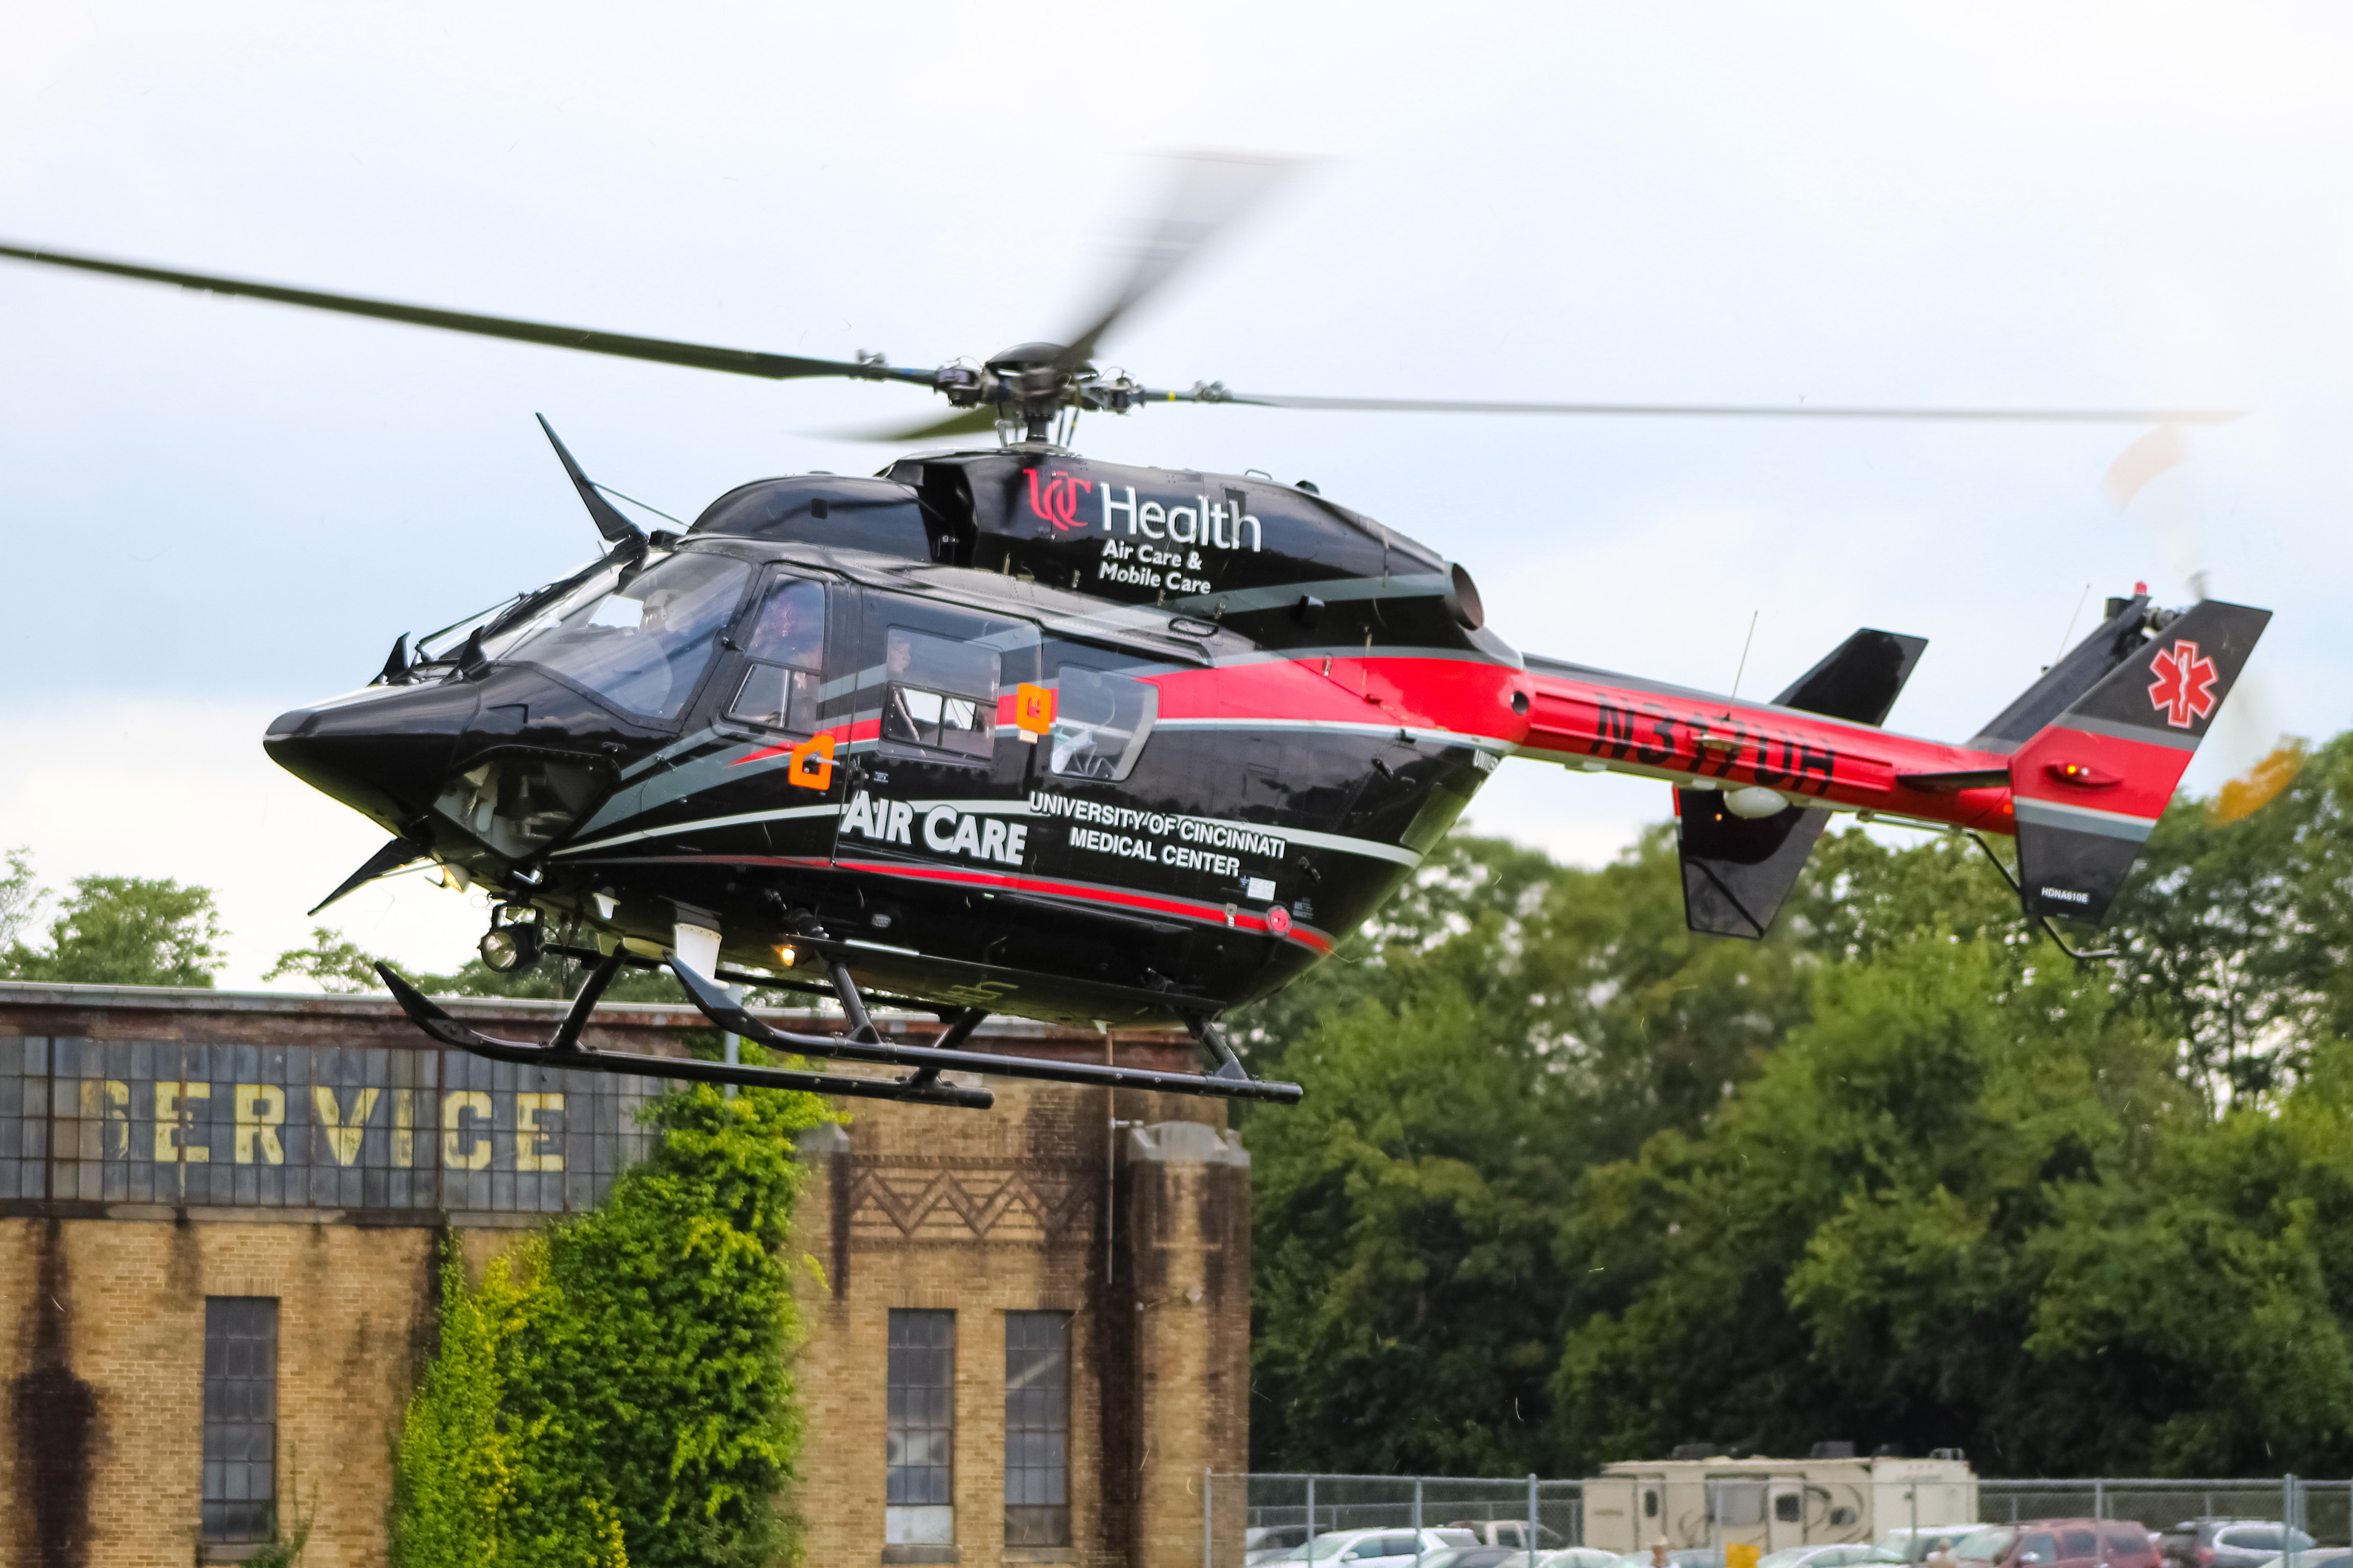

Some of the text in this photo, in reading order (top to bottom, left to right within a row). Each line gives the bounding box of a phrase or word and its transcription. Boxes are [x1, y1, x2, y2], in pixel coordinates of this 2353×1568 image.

[1099, 481, 1262, 552] Health
[1099, 561, 1211, 594] Mobile Care
[1102, 538, 1202, 570] Air Care &
[840, 790, 1028, 865] AIR CARE
[1029, 791, 1286, 859] UNIVERSITY OF CINCINNATI
[1069, 827, 1240, 877] MEDICAL CENTER
[2041, 887, 2089, 904] HDNA610E
